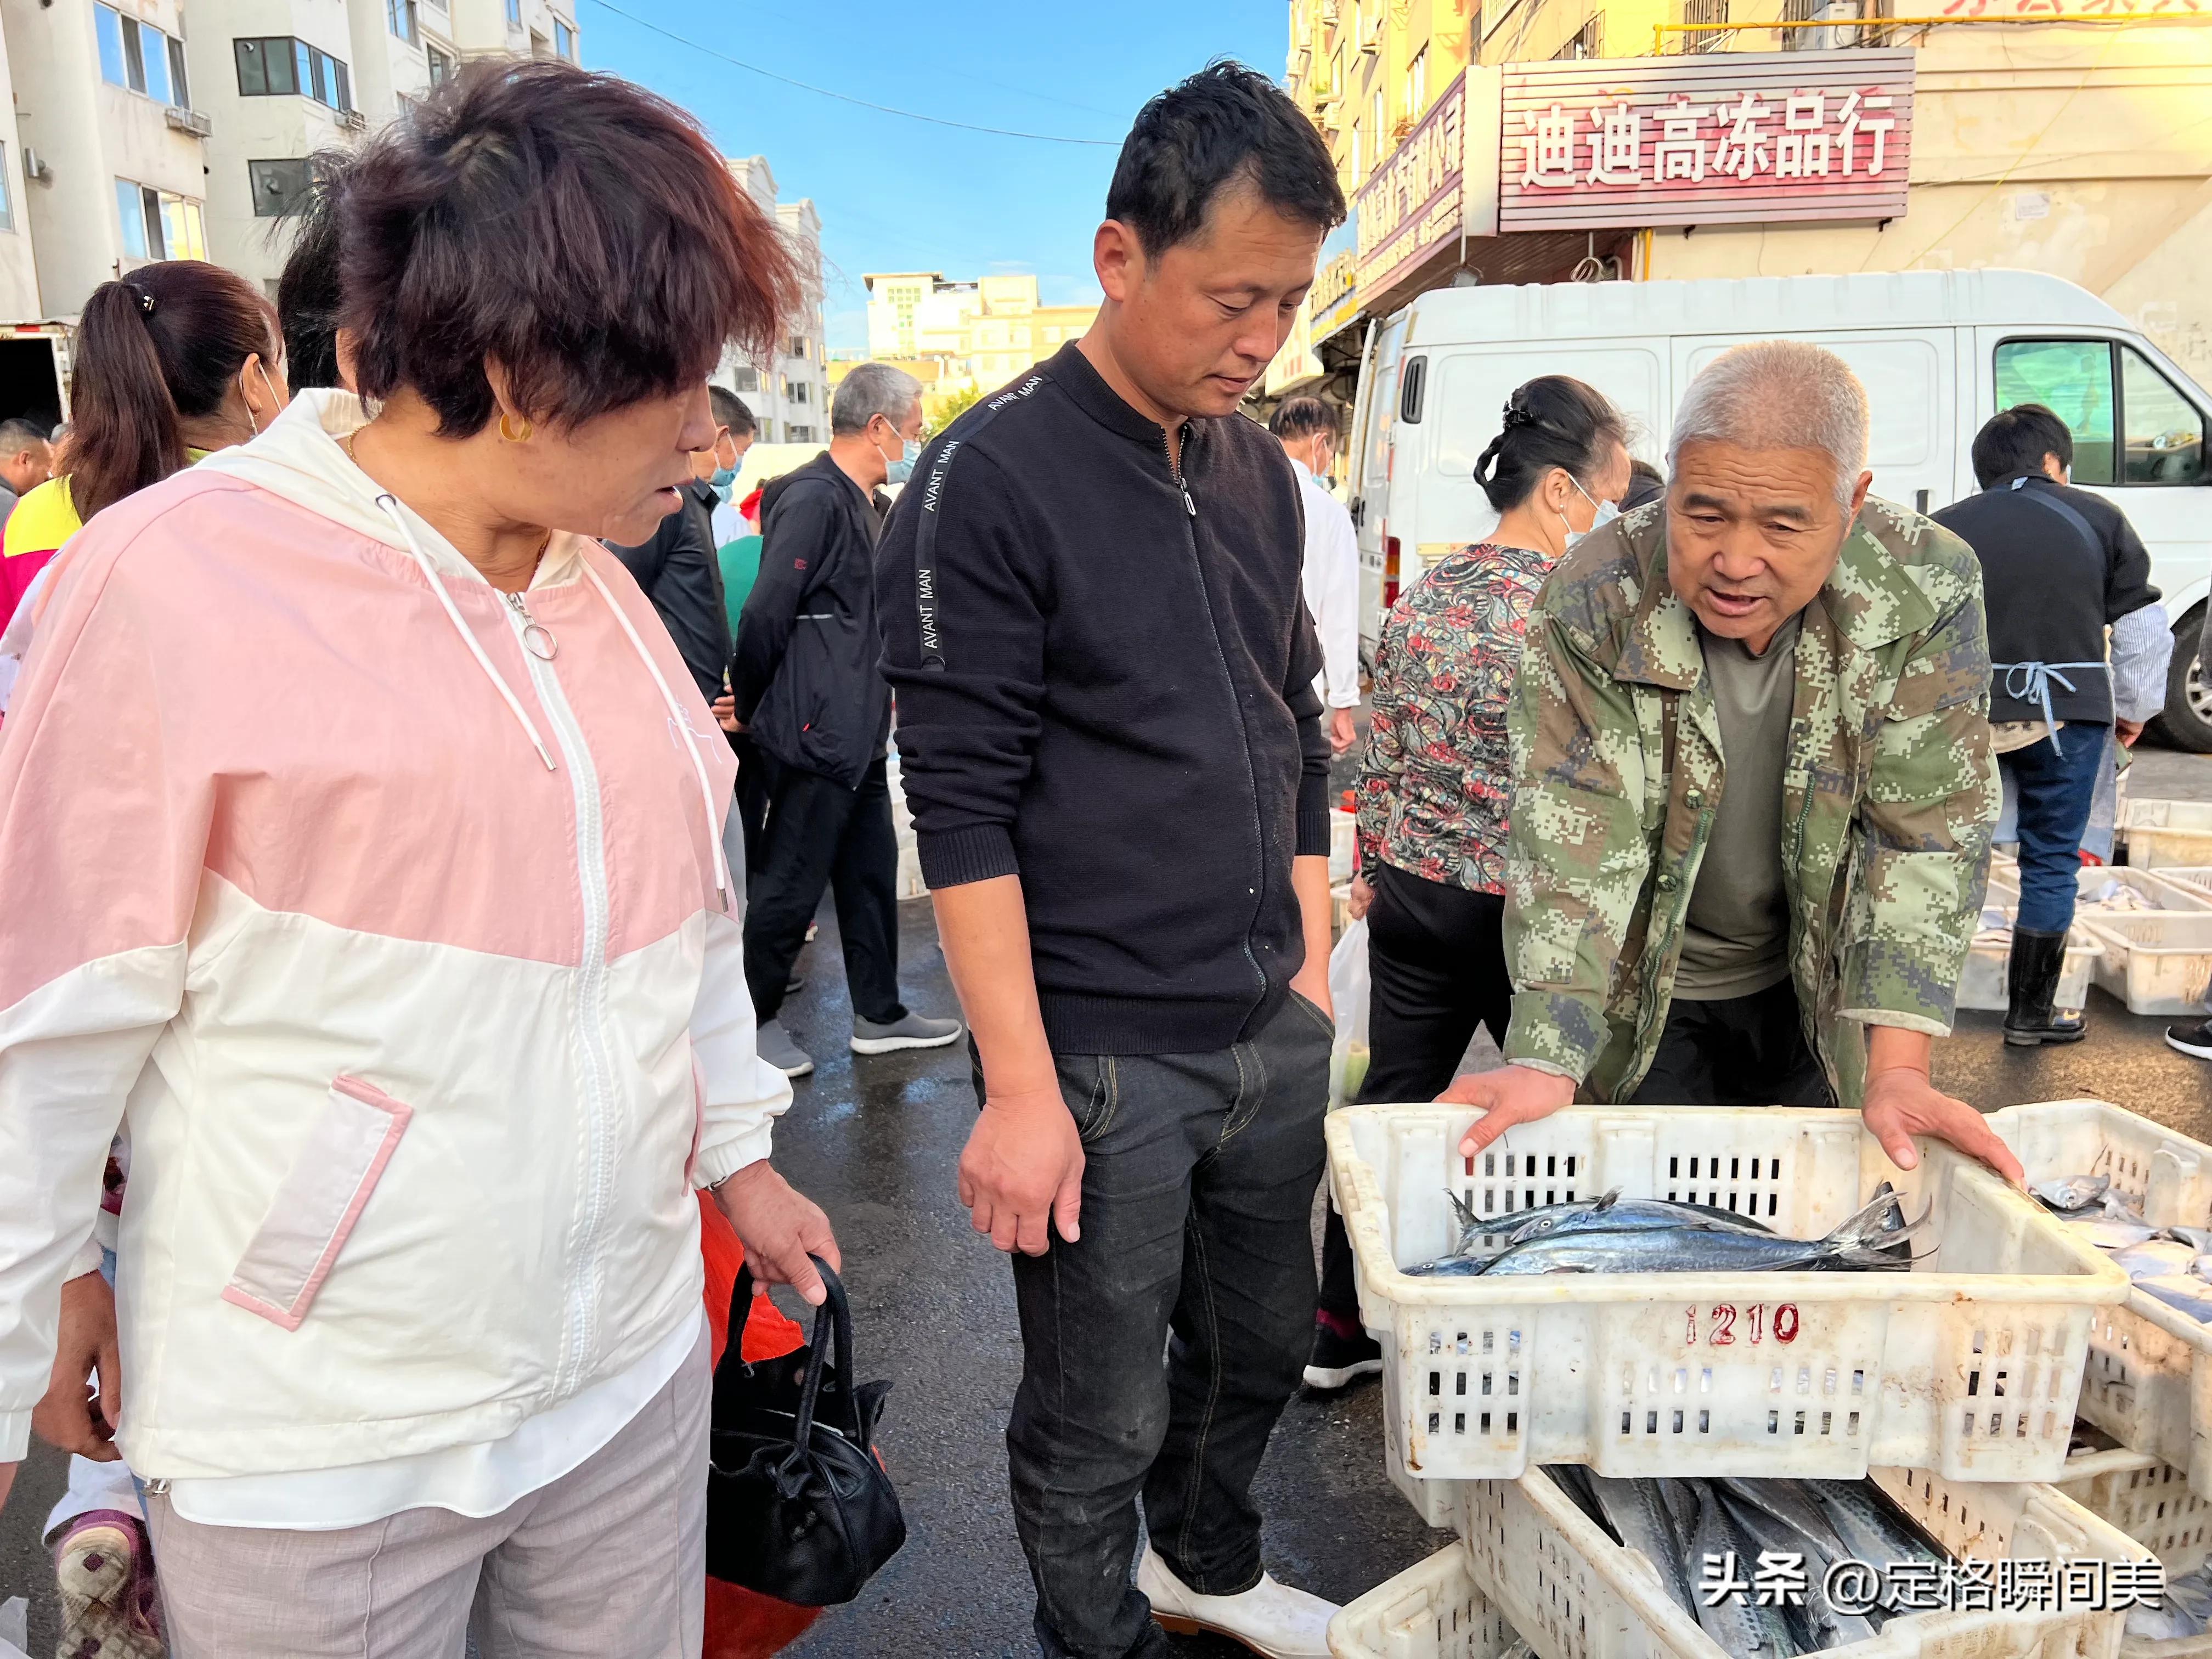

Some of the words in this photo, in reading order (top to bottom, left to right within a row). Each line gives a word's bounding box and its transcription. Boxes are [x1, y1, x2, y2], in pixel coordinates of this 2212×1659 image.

[1520, 91, 1894, 189] 迪迪高冻品行
[988, 392, 1019, 411] AVANT
[1018, 375, 1042, 397] MAN
[923, 469, 944, 511] AVANT
[937, 439, 960, 464] MAN
[918, 568, 932, 600] MAN
[919, 605, 938, 648] AVANT
[1685, 1303, 1799, 1345] 1210
